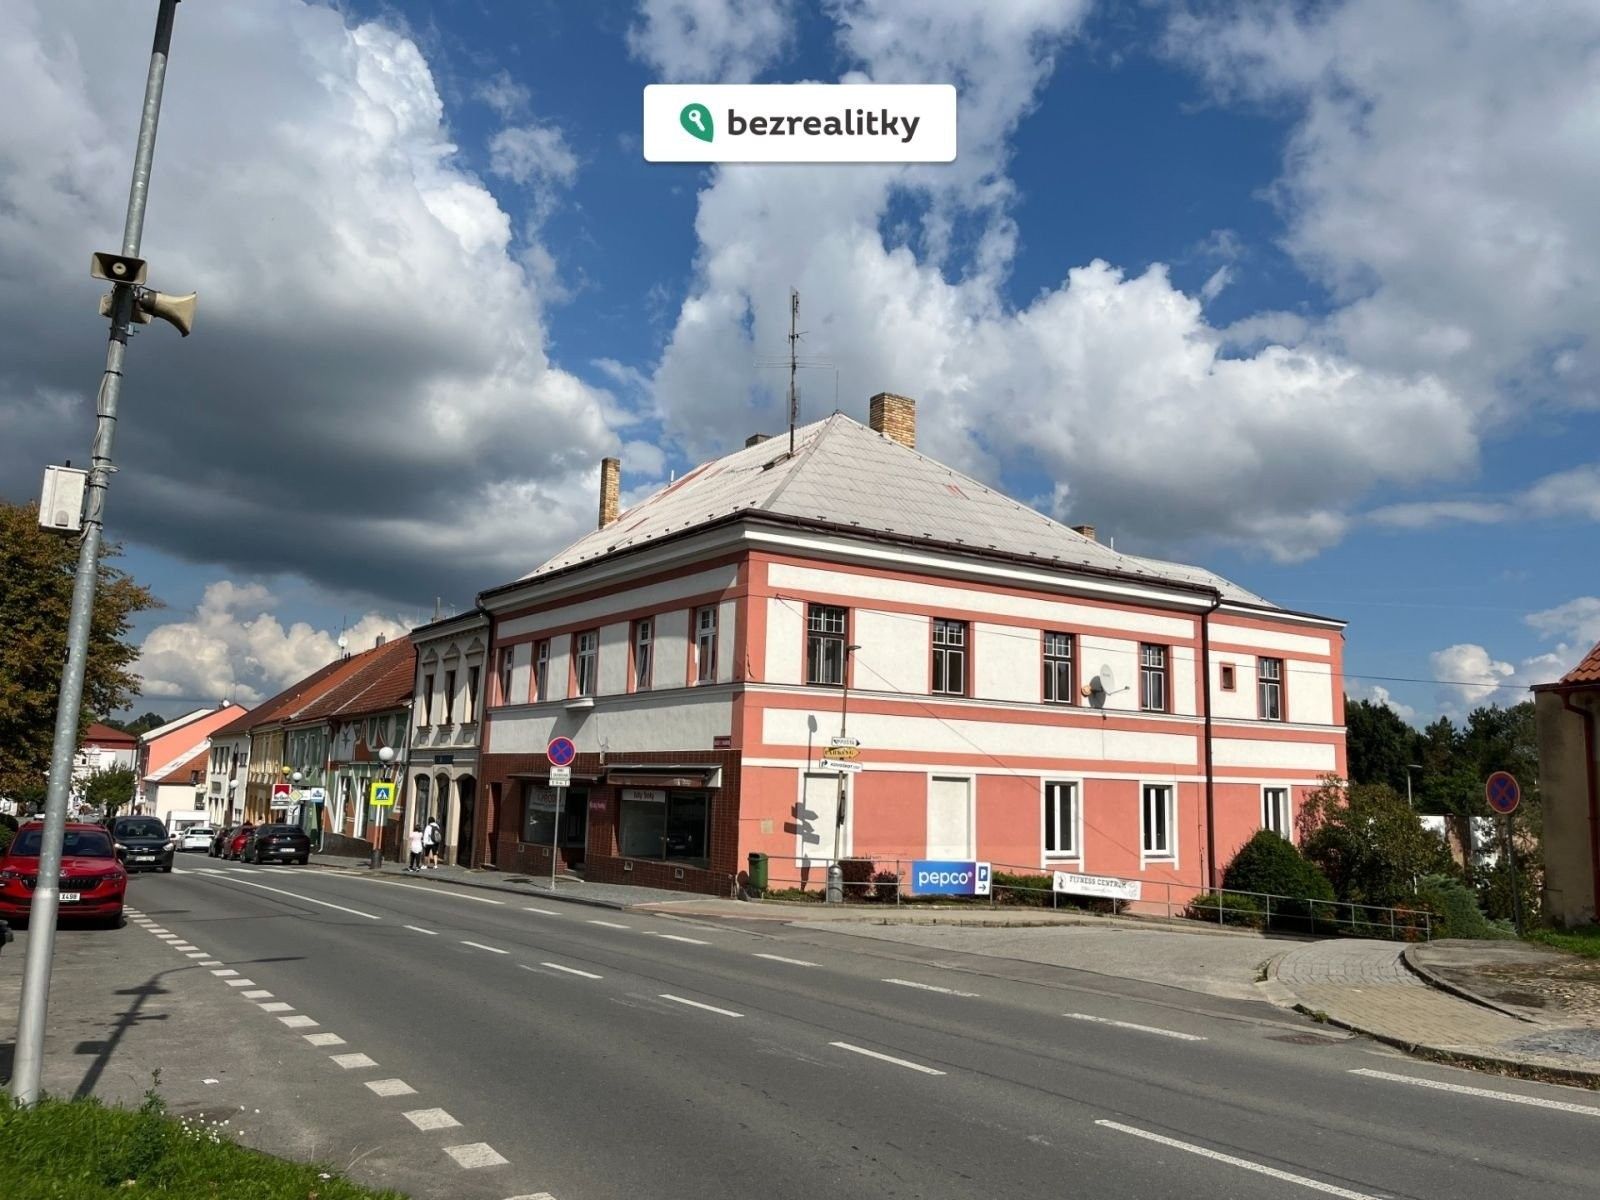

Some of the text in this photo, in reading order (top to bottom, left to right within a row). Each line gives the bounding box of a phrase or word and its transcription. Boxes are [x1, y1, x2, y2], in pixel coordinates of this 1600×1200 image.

[918, 871, 969, 887] pepco
[980, 869, 987, 879] P
[1069, 875, 1096, 886] FITNESS
